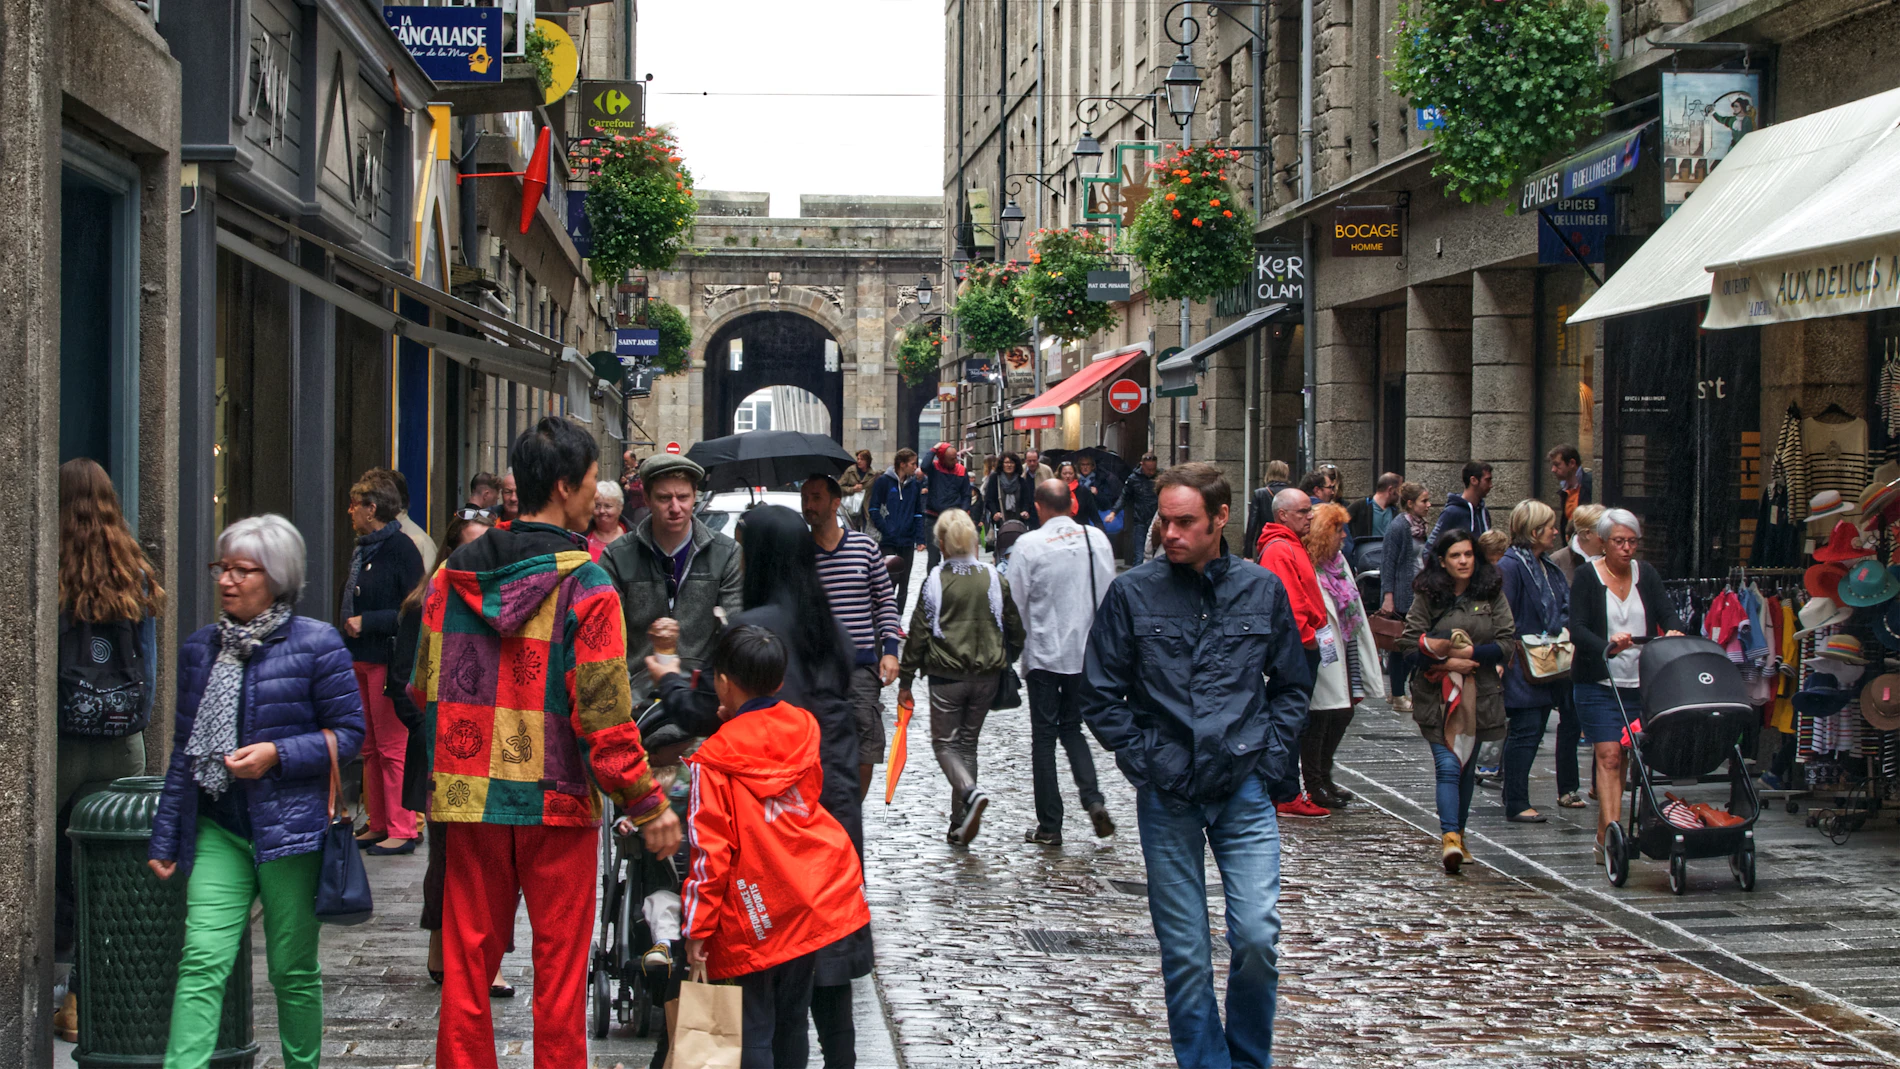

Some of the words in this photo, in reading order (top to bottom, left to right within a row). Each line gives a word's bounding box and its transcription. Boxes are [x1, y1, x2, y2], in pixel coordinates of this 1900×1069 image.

[401, 15, 412, 26] LA
[588, 118, 635, 128] Carrefour
[1335, 224, 1399, 239] BOCAGE
[1351, 243, 1383, 251] HOMME
[1775, 269, 1812, 306] AUX
[1815, 256, 1881, 299] DELICES
[1257, 283, 1303, 299] OLAM
[748, 883, 767, 913] SPORTS
[740, 890, 767, 940] PERFORMANCE
